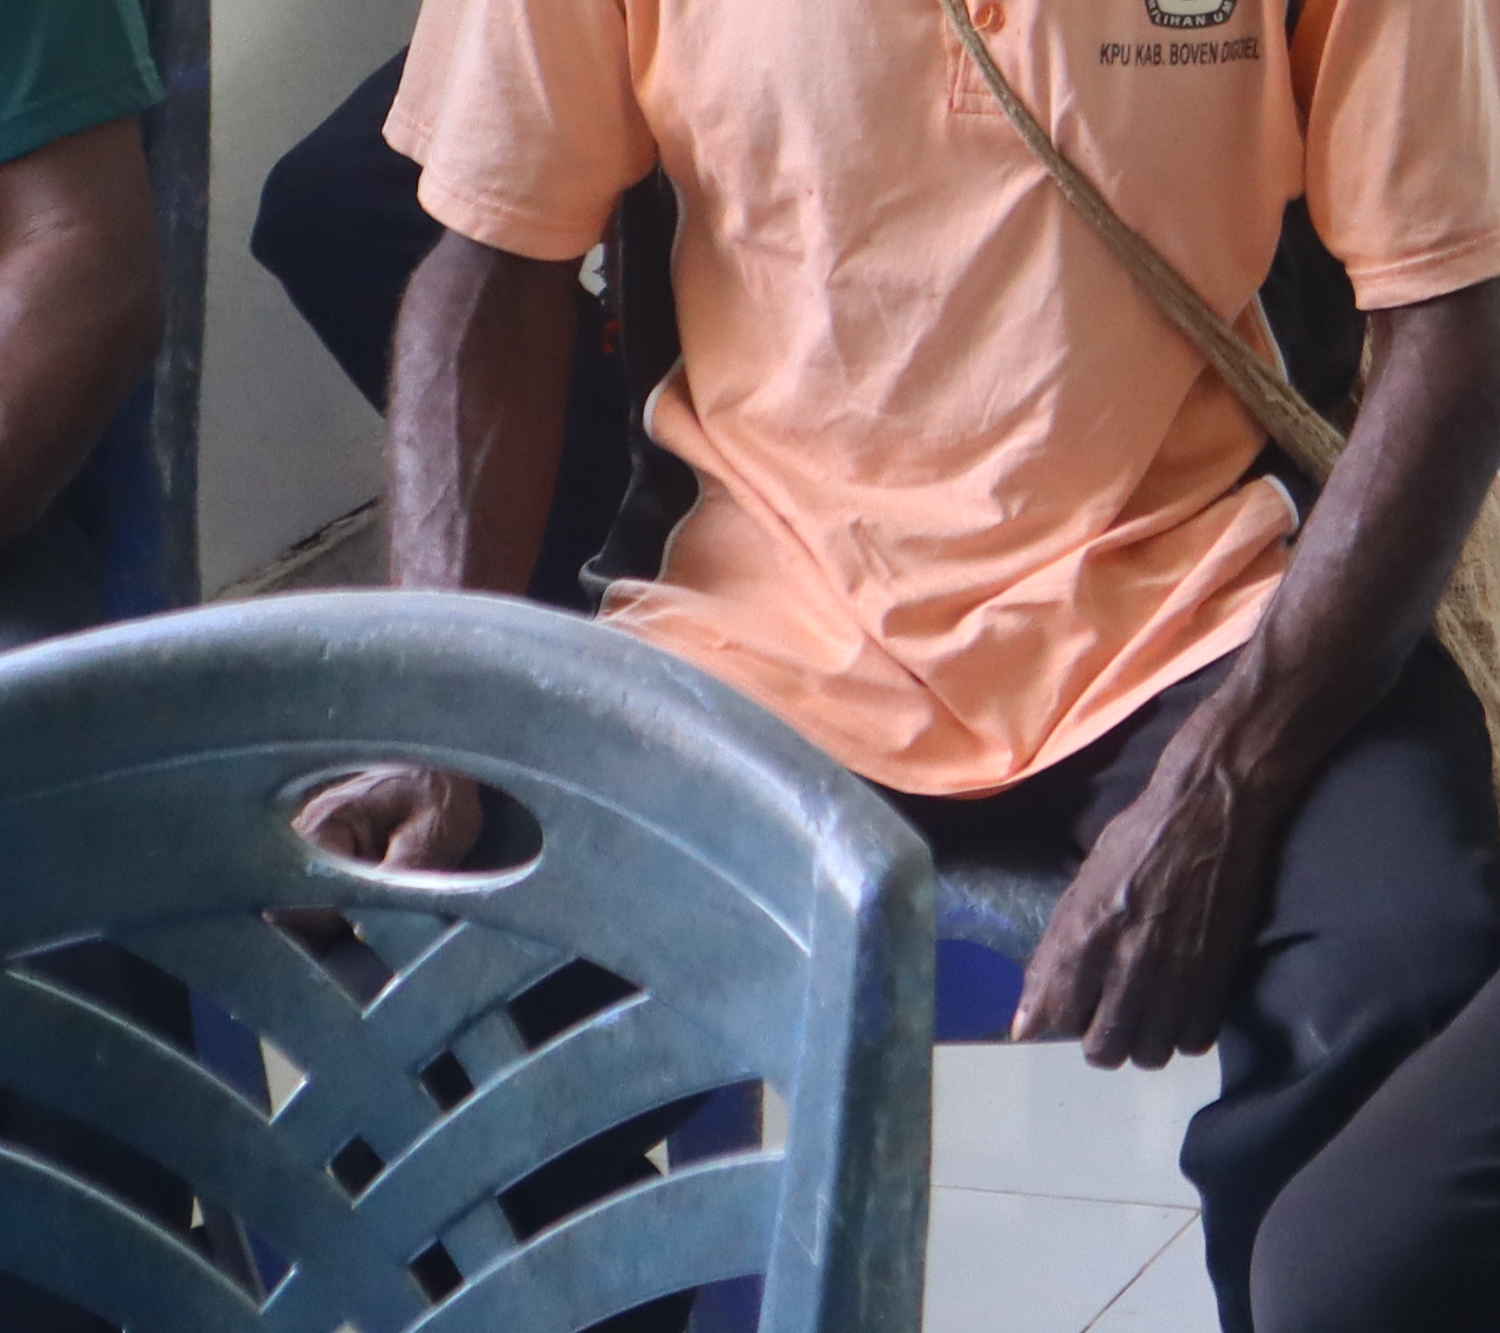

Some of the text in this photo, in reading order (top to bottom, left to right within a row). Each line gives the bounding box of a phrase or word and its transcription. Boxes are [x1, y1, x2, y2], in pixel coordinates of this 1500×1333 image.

[1099, 42, 1131, 66] KPU
[1134, 42, 1166, 66] KAB.
[1170, 41, 1218, 65] BOVEN
